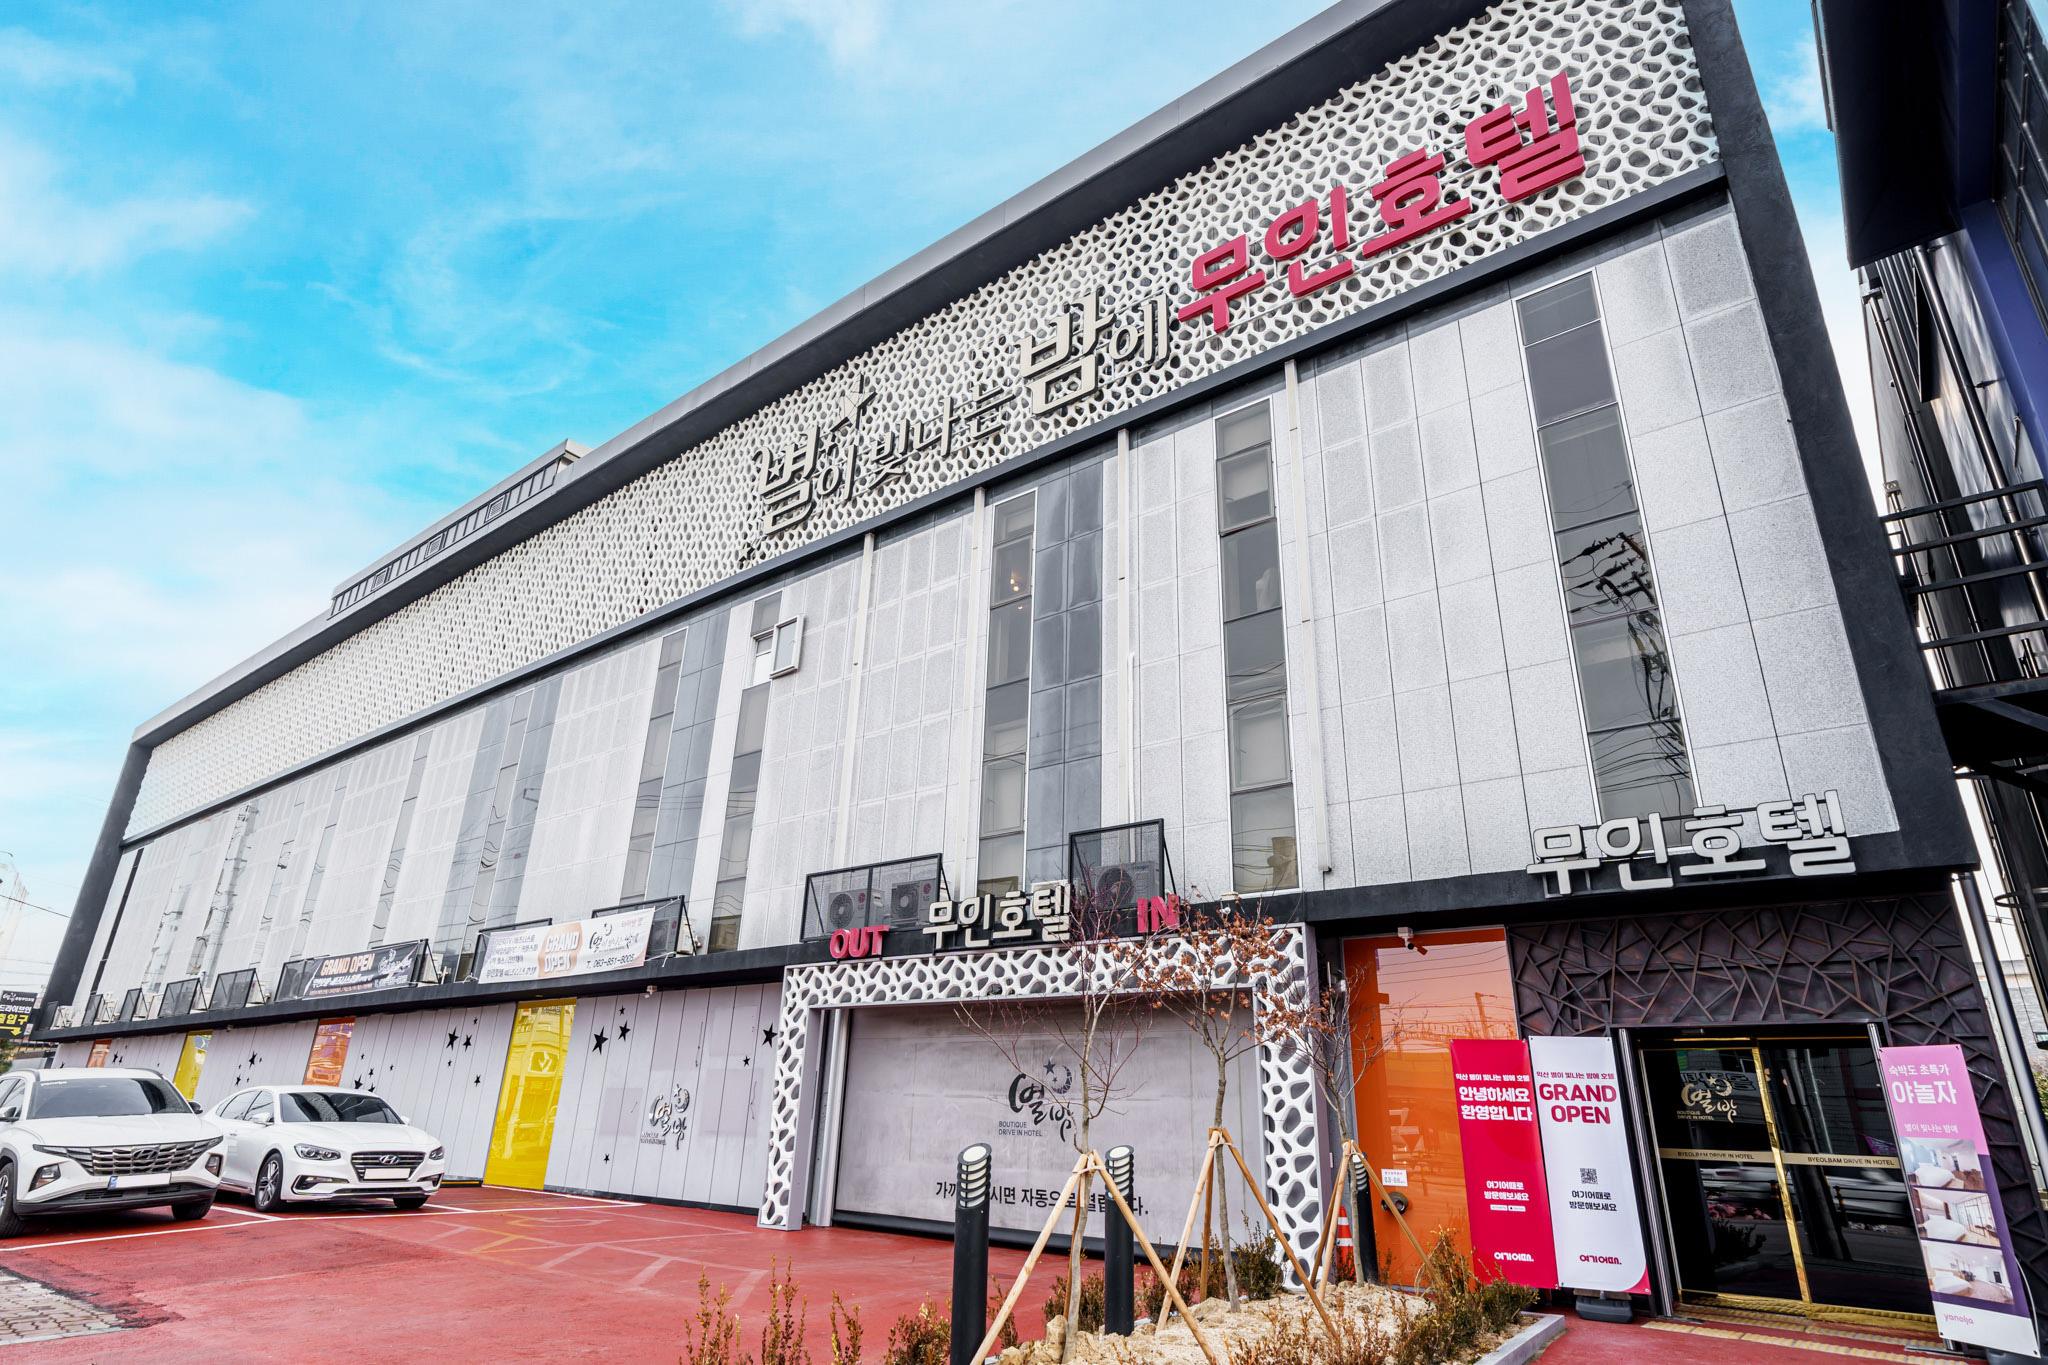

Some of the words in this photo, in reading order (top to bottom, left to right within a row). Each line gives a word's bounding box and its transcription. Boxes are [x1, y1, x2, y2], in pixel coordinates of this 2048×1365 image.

[752, 425, 858, 535] 별이
[868, 376, 1017, 490] 빛나는
[1017, 287, 1170, 417] 밤에
[1177, 71, 1586, 334] 무인호텔
[1526, 789, 1857, 895] 무인호텔
[922, 883, 1074, 949] 무인호텔
[1137, 893, 1181, 934] IN
[545, 931, 580, 953] GRAND
[829, 924, 891, 959] OUT
[320, 957, 351, 977] GRAND
[350, 953, 376, 974] OPEN
[1888, 1064, 1918, 1076] 숙박도
[1919, 1064, 1950, 1076] 초특가
[1459, 1086, 1531, 1103] 안녕하세요
[1538, 1083, 1618, 1103] GRAND
[1892, 1080, 1957, 1105] 야놀자
[1461, 1104, 1533, 1121] 환영합니다
[1551, 1104, 1611, 1125] OPEN
[998, 1120, 1028, 1128] BOUTIQUE
[998, 1128, 1016, 1136] DRIVE
[1024, 1129, 1043, 1137] HOTEL
[1904, 1123, 1919, 1132] 별이
[1920, 1123, 1942, 1133] 빛나는
[1943, 1124, 1959, 1134] 밤에
[1486, 1180, 1525, 1191] 여기어때로
[1484, 1190, 1530, 1201] 방문해보세요
[1571, 1190, 1612, 1201] 여기어때로
[1569, 1200, 1618, 1212] 방문해보세요
[1943, 1312, 1975, 1326] yanolja
